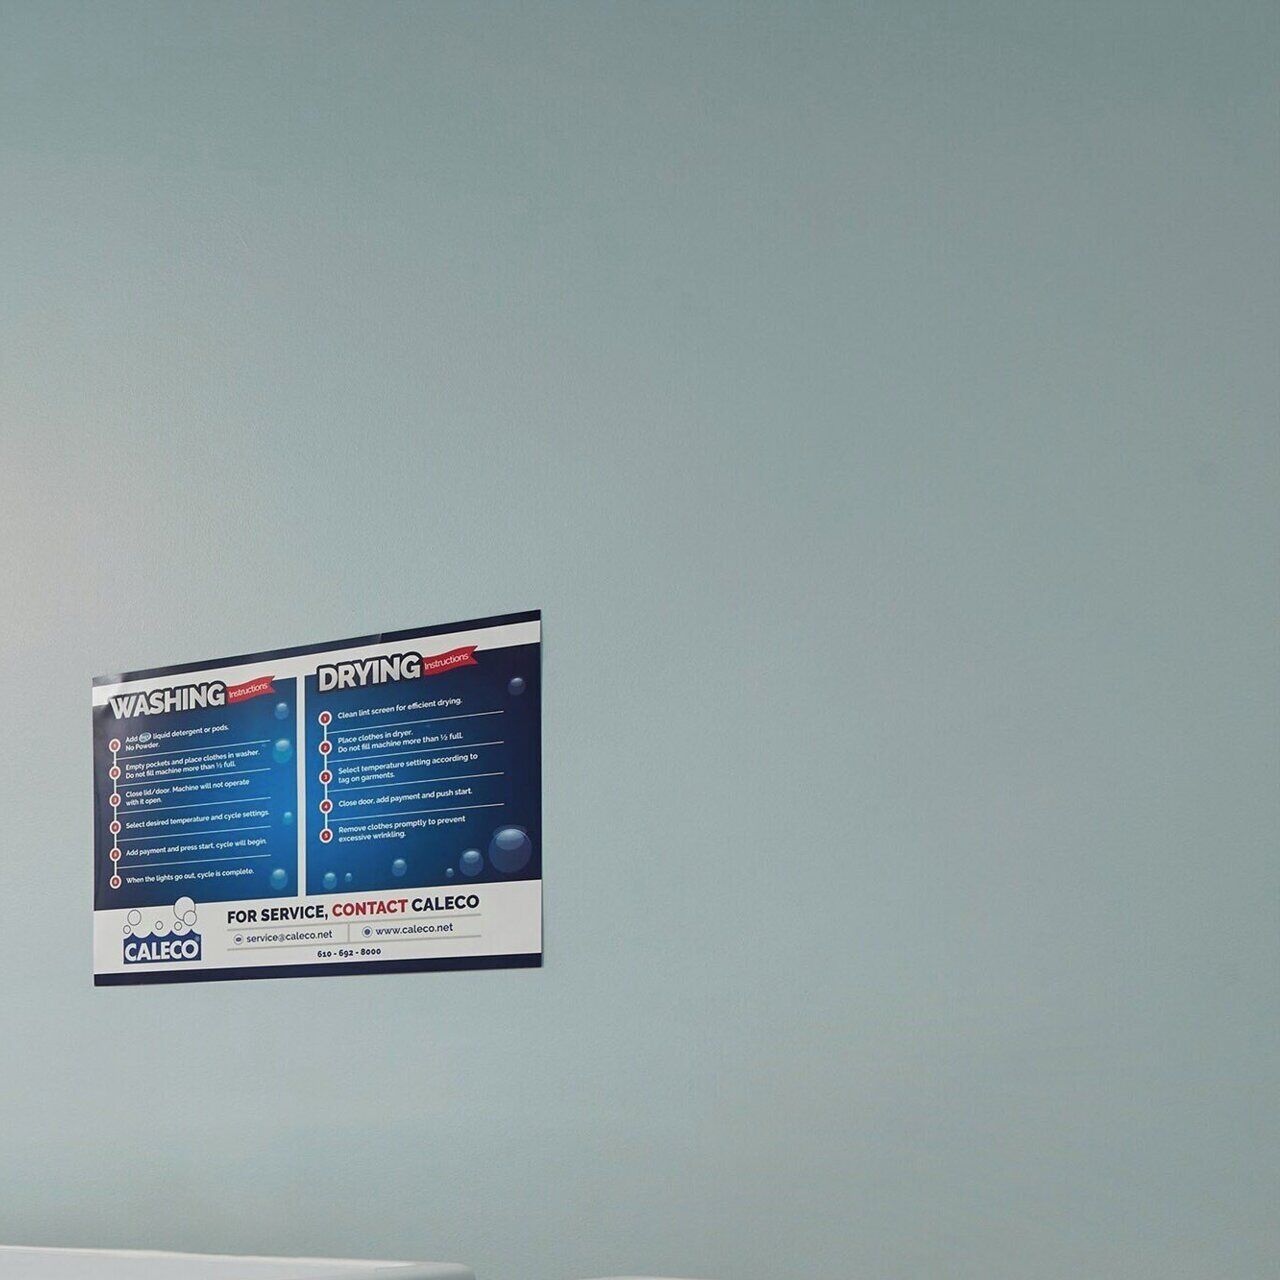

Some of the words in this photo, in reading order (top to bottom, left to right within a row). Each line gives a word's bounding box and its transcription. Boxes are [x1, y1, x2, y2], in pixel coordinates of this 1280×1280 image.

[319, 655, 420, 691] DRYING
[425, 653, 468, 670] Instructions
[110, 684, 225, 719] WASHING
[229, 683, 268, 699] Instructions
[338, 710, 357, 718] Clean
[407, 700, 436, 710] efficient
[437, 697, 462, 709] drying.
[228, 910, 257, 924] FOR
[261, 906, 328, 922] SERVICE,
[332, 899, 408, 917] CONTACT
[412, 895, 479, 912] CALECO
[247, 930, 332, 943] service@caleco.net
[376, 922, 453, 937] www.caleco.net
[125, 940, 199, 962] CALECO
